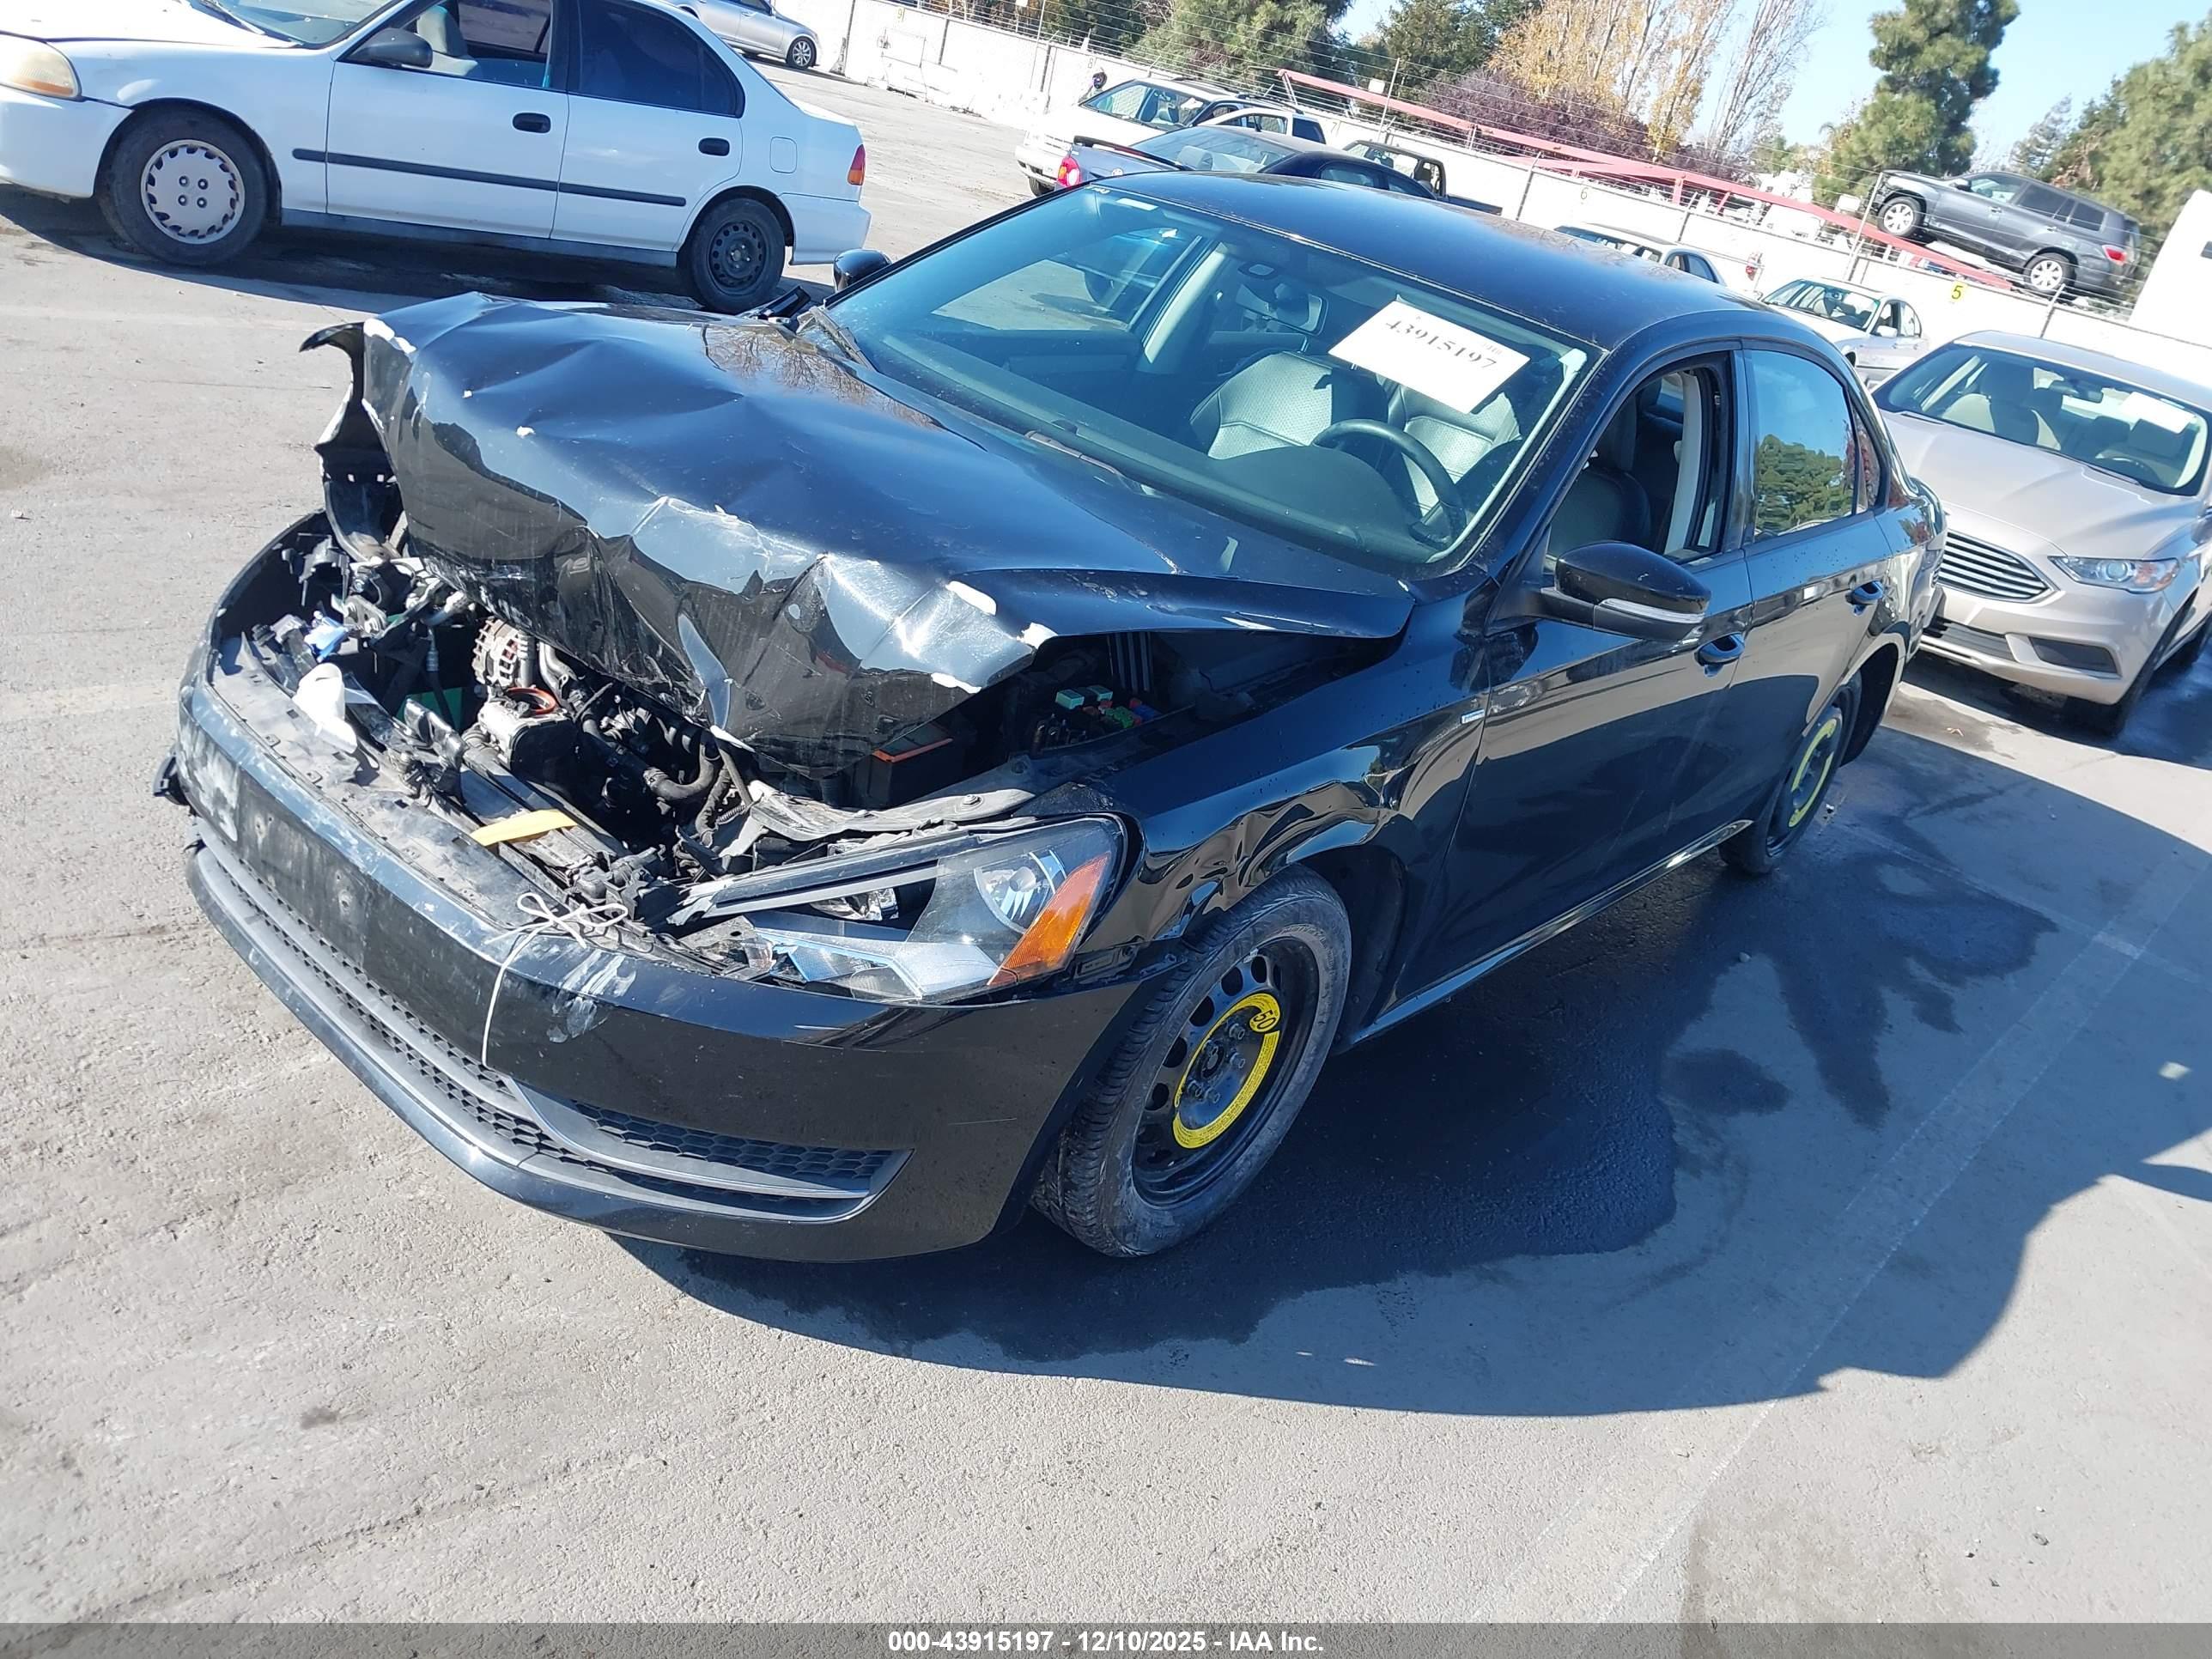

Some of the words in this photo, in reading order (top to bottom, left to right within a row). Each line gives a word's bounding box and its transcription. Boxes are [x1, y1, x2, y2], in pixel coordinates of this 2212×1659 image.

[896, 8, 902, 19] 9
[1580, 186, 1589, 200] 6
[1951, 284, 1964, 300] 5
[1384, 319, 1498, 370] 43915197
[1253, 1009, 1278, 1030] 50
